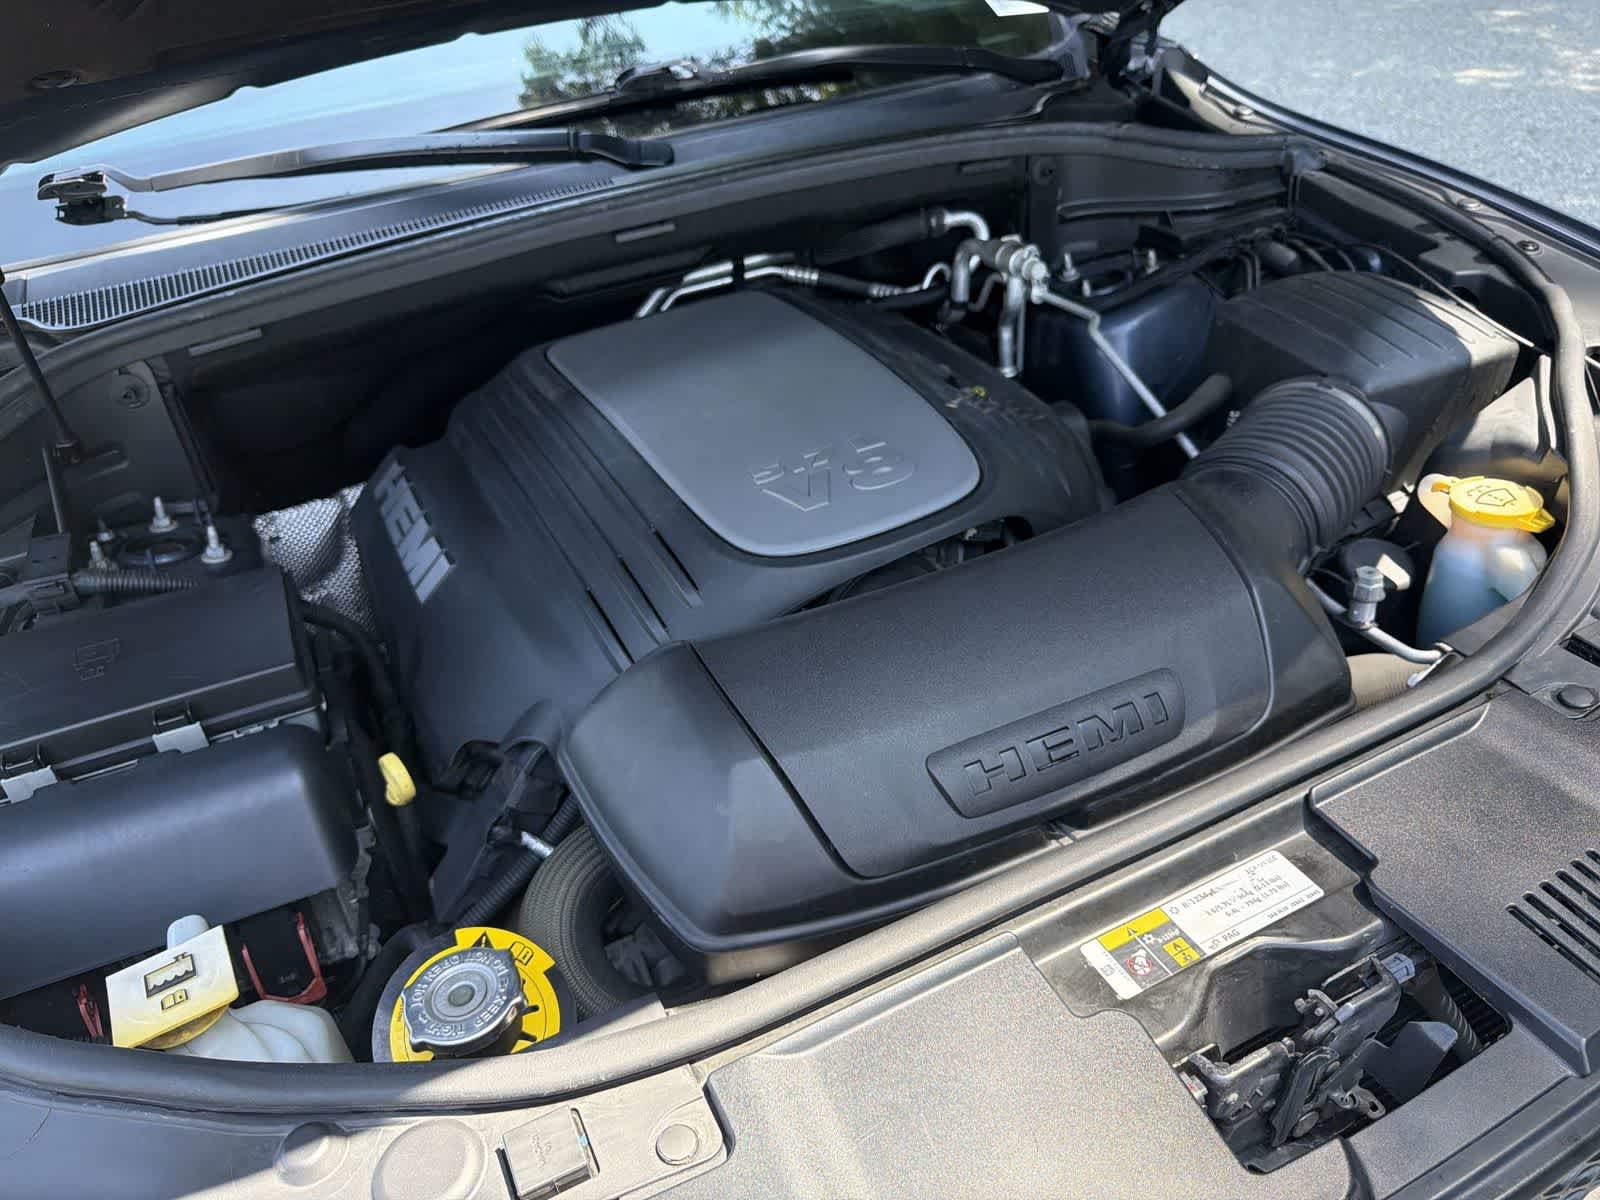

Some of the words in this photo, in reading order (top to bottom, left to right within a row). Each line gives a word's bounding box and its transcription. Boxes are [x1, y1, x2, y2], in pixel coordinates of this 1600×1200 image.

[751, 433, 917, 511] V8
[374, 461, 451, 604] HEMI
[964, 692, 1169, 796] HEMI
[1222, 928, 1241, 942] PAG
